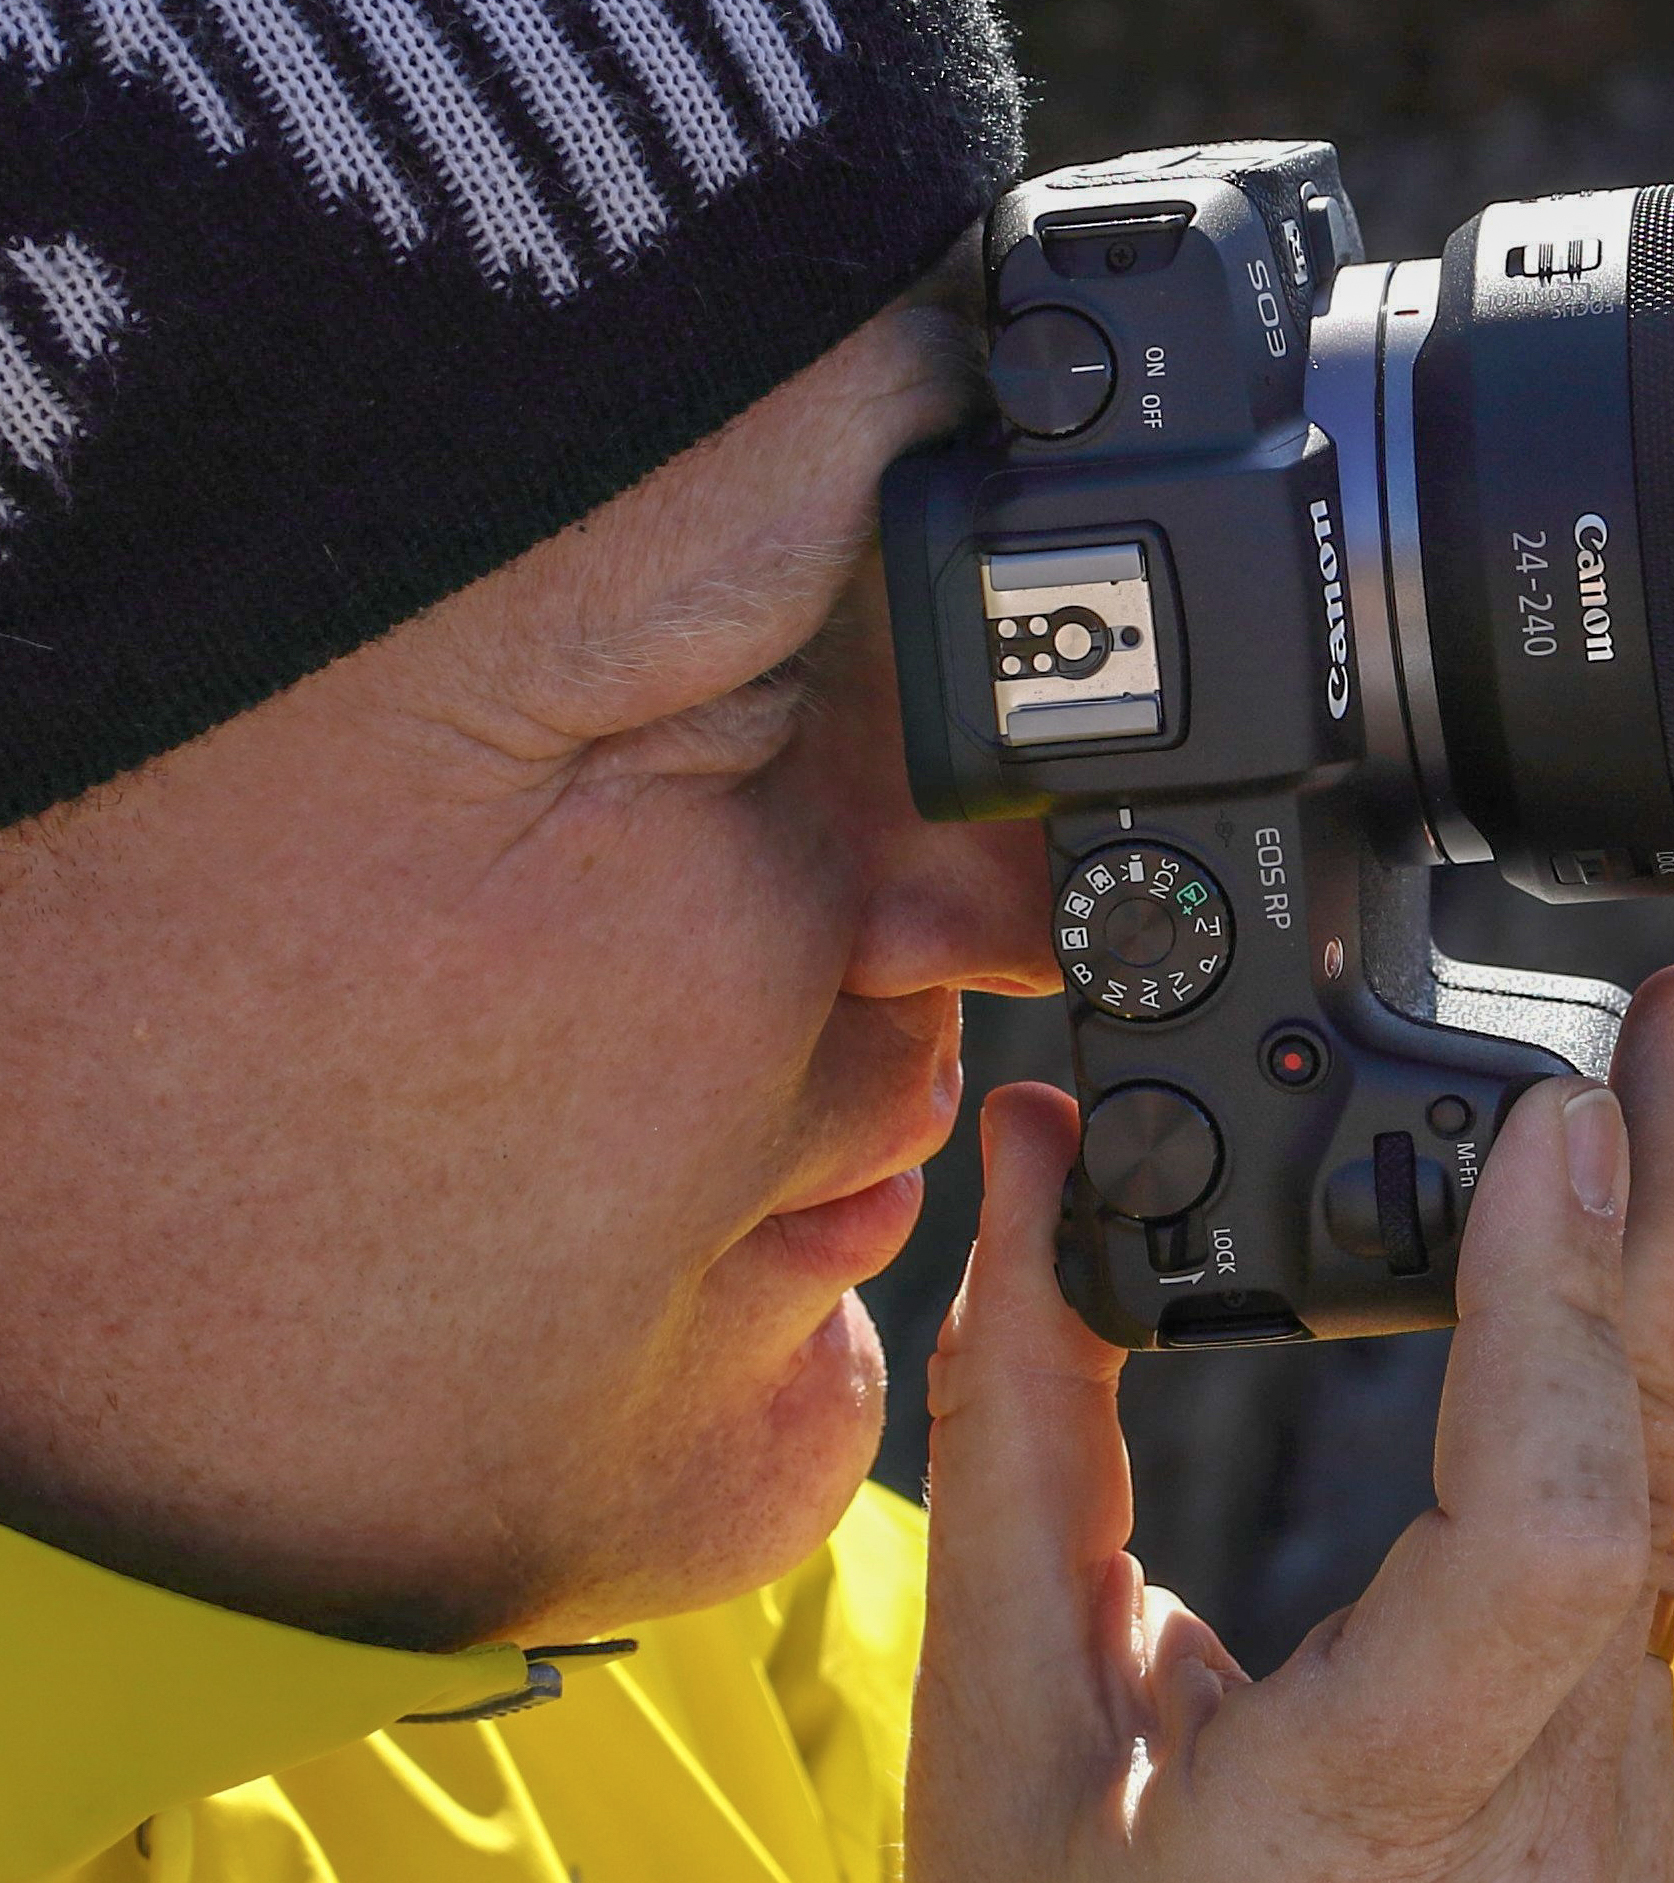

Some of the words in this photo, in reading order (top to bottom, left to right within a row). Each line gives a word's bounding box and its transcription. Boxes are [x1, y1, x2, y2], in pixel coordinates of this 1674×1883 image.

[1247, 259, 1286, 359] EOS
[1144, 346, 1166, 378] ON
[1141, 394, 1163, 429] OFF
[1512, 530, 1558, 657] 24-240
[1574, 513, 1615, 662] Canon
[1310, 500, 1348, 720] Canon
[1255, 827, 1285, 887] EOS
[1088, 866, 1113, 893] C3
[1149, 859, 1180, 900] SCN
[1068, 894, 1090, 916] C2
[1264, 894, 1292, 930] RP
[1063, 929, 1088, 948] C1
[1072, 963, 1093, 986] B
[1200, 954, 1218, 975] P
[1102, 980, 1127, 1006] M
[1456, 1142, 1479, 1188] M-Fn
[1212, 1228, 1236, 1275] LOCK
